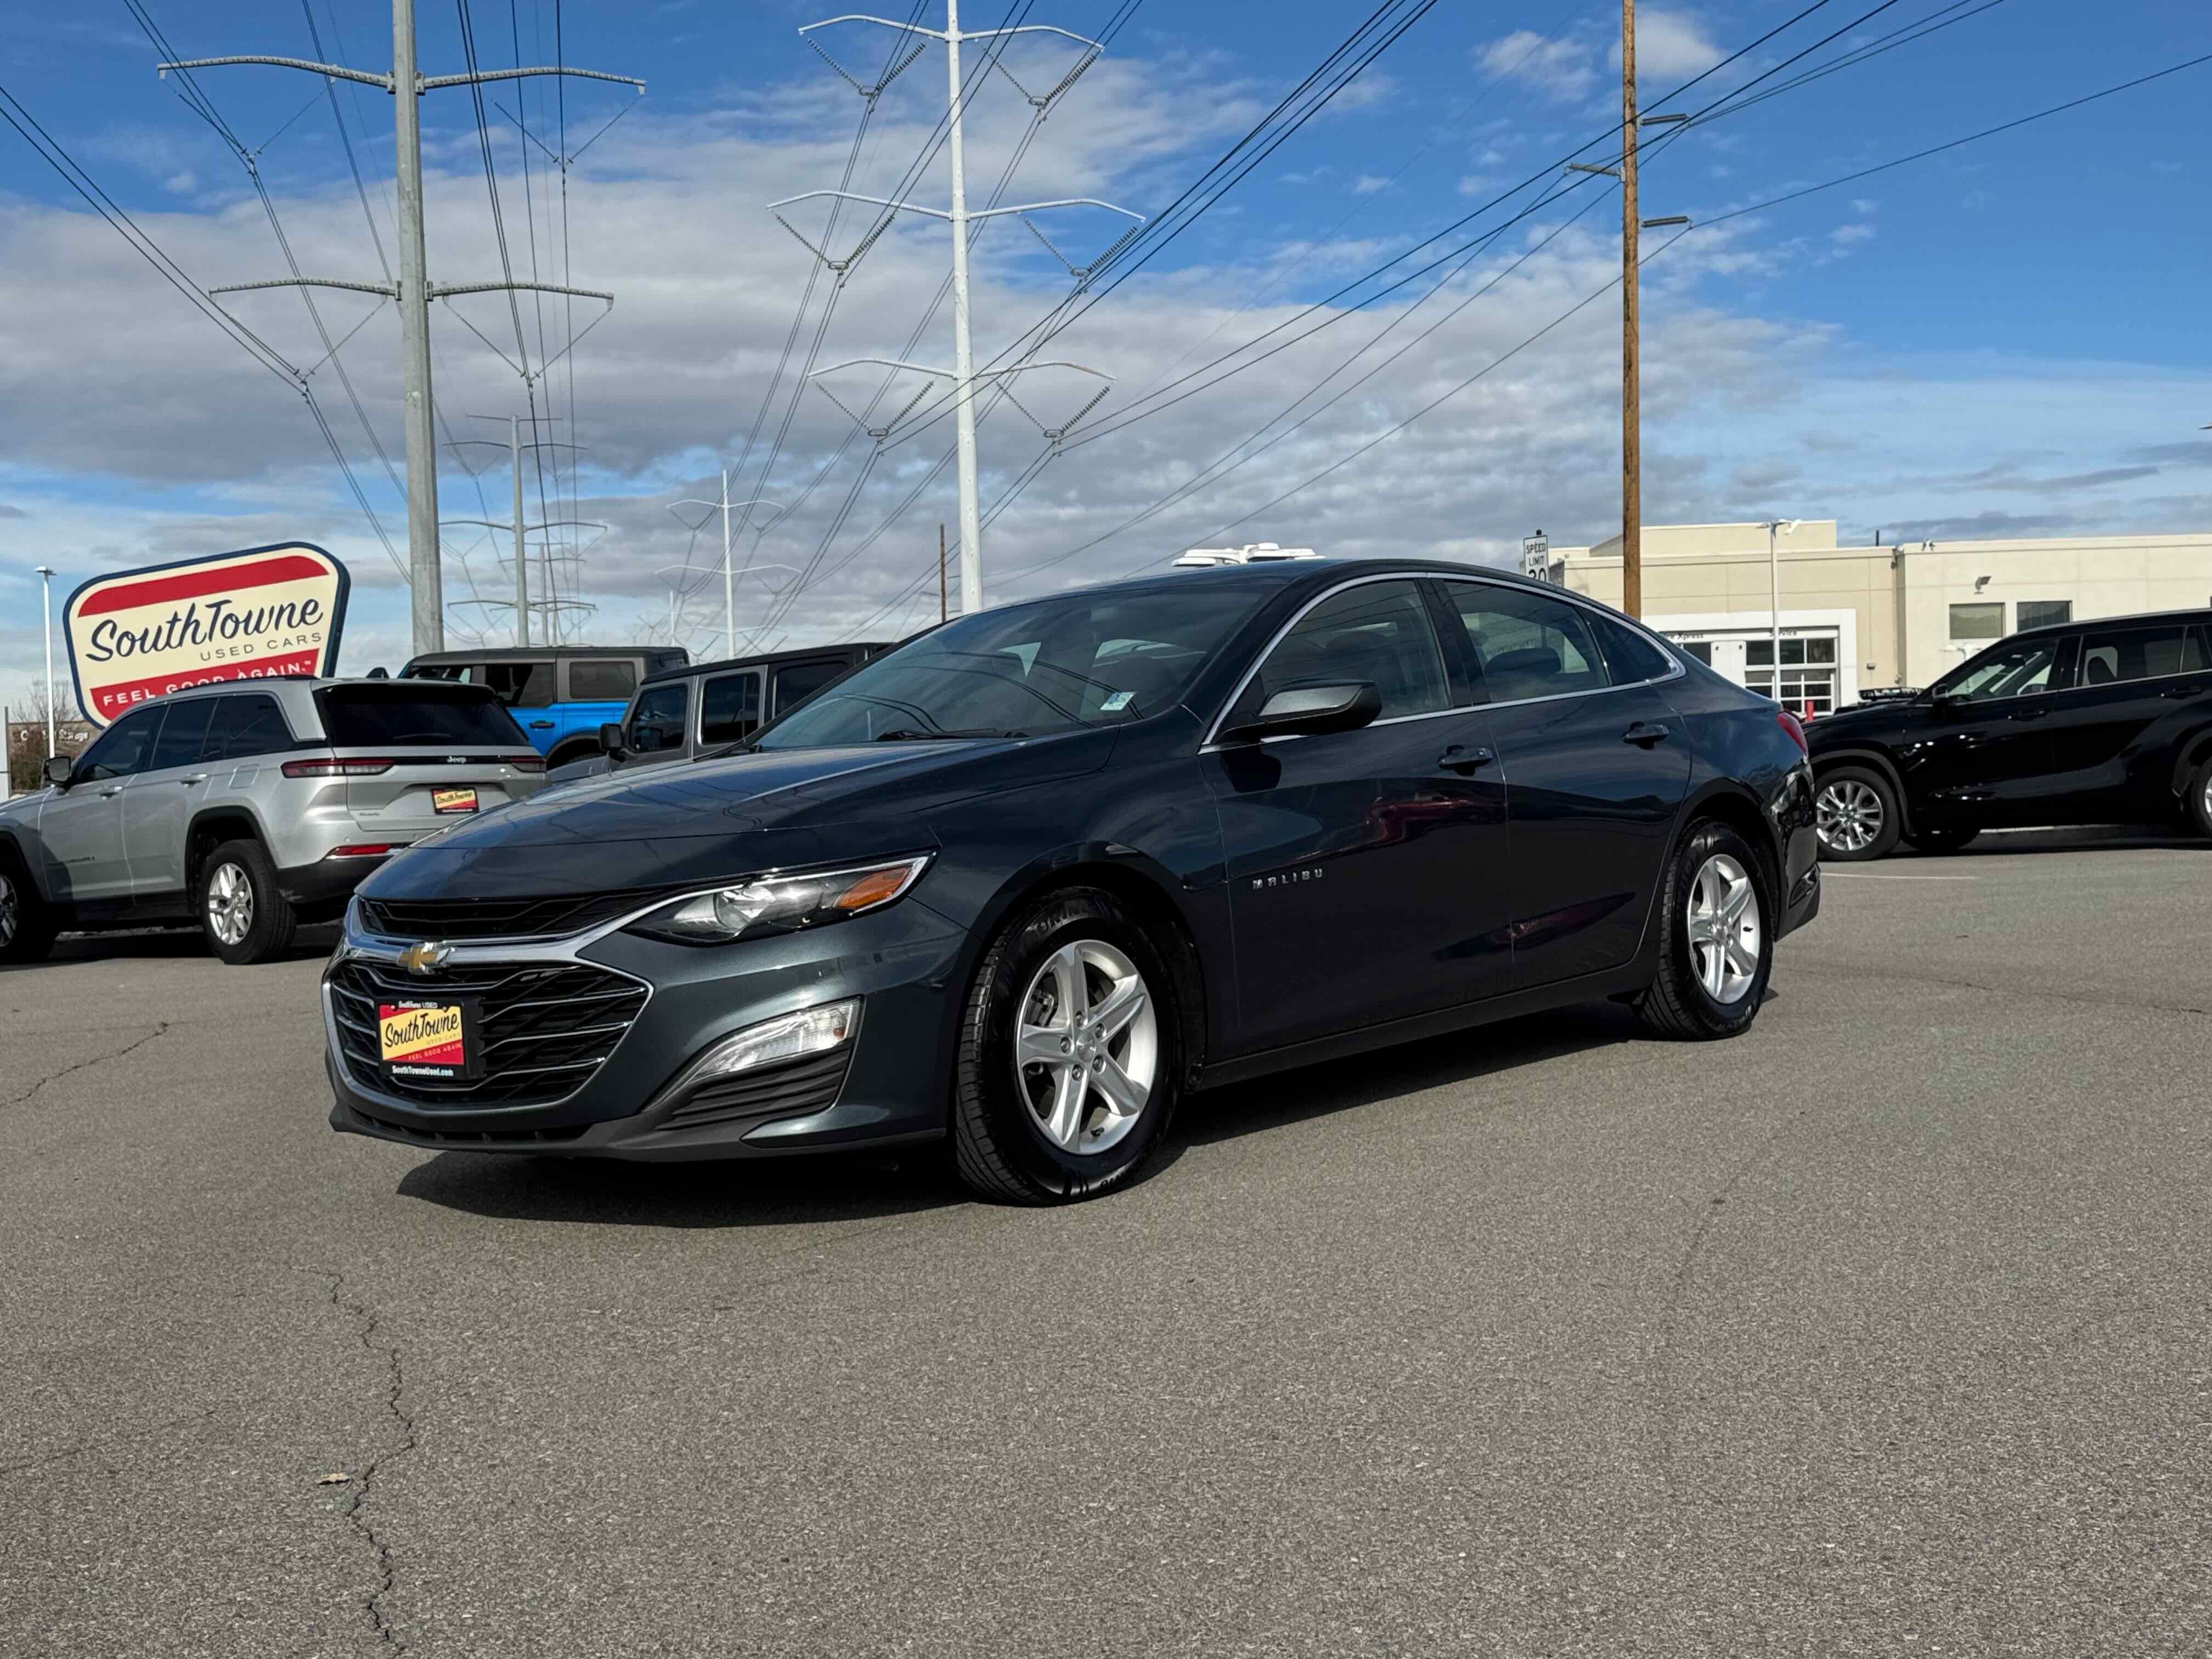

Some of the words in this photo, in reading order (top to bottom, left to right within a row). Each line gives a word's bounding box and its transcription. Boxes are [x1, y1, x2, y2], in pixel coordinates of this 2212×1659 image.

[1526, 542, 1546, 554] SPEED
[1528, 555, 1545, 567] LIMIT
[85, 598, 324, 662] SouthTowne
[200, 644, 255, 662] USED
[267, 632, 321, 650] CARS
[103, 689, 156, 707] FEEL
[447, 755, 466, 764] Jeep
[1252, 868, 1323, 890] MALIBU
[384, 1012, 460, 1048] SouthTowne
